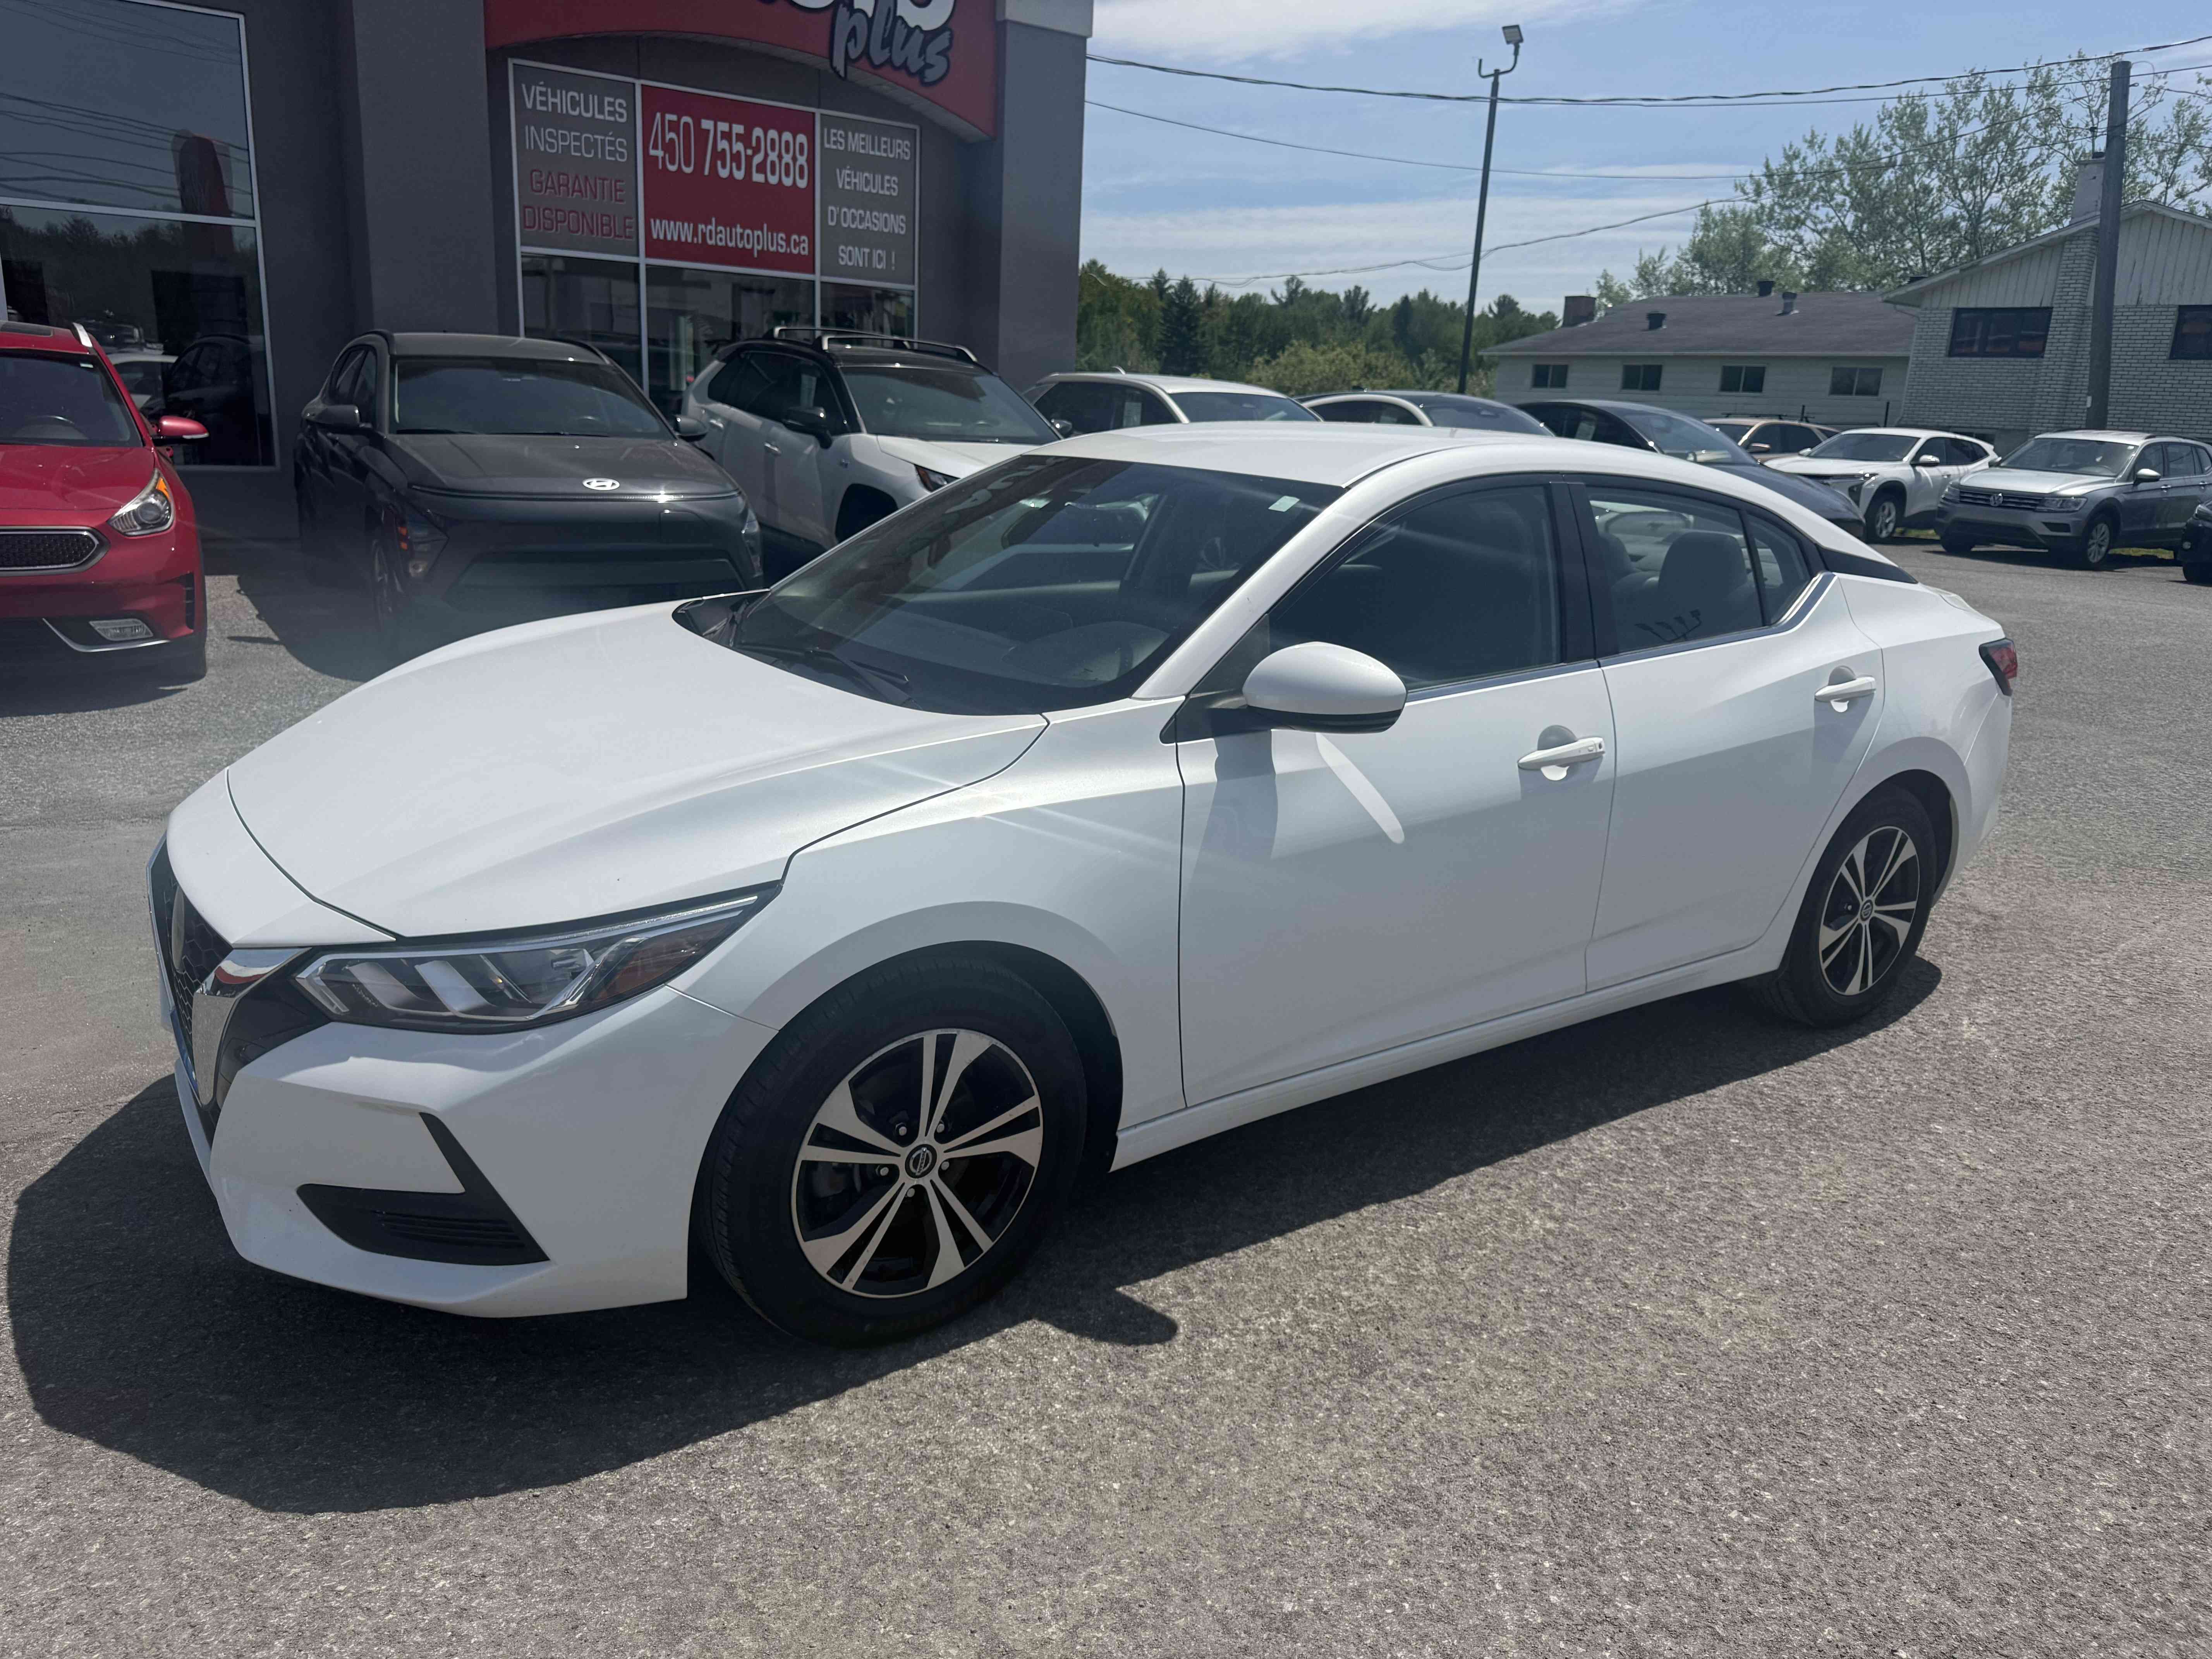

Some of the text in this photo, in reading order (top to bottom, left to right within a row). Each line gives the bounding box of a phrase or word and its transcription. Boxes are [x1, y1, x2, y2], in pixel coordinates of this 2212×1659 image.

[830, 0, 952, 83] plus
[522, 81, 627, 123] VÉHICULES
[525, 125, 627, 162] INSPECTÉS
[649, 112, 809, 189] 450 755-2888
[824, 128, 911, 160] LES MEILLEURS
[530, 169, 626, 204] GARANTIE
[836, 166, 898, 196] VÉHICULES
[523, 205, 635, 240] DISPONIBLE
[650, 217, 809, 258] www.rdautoplus.ca
[838, 245, 870, 268] SONT
[872, 249, 886, 270] ICI
